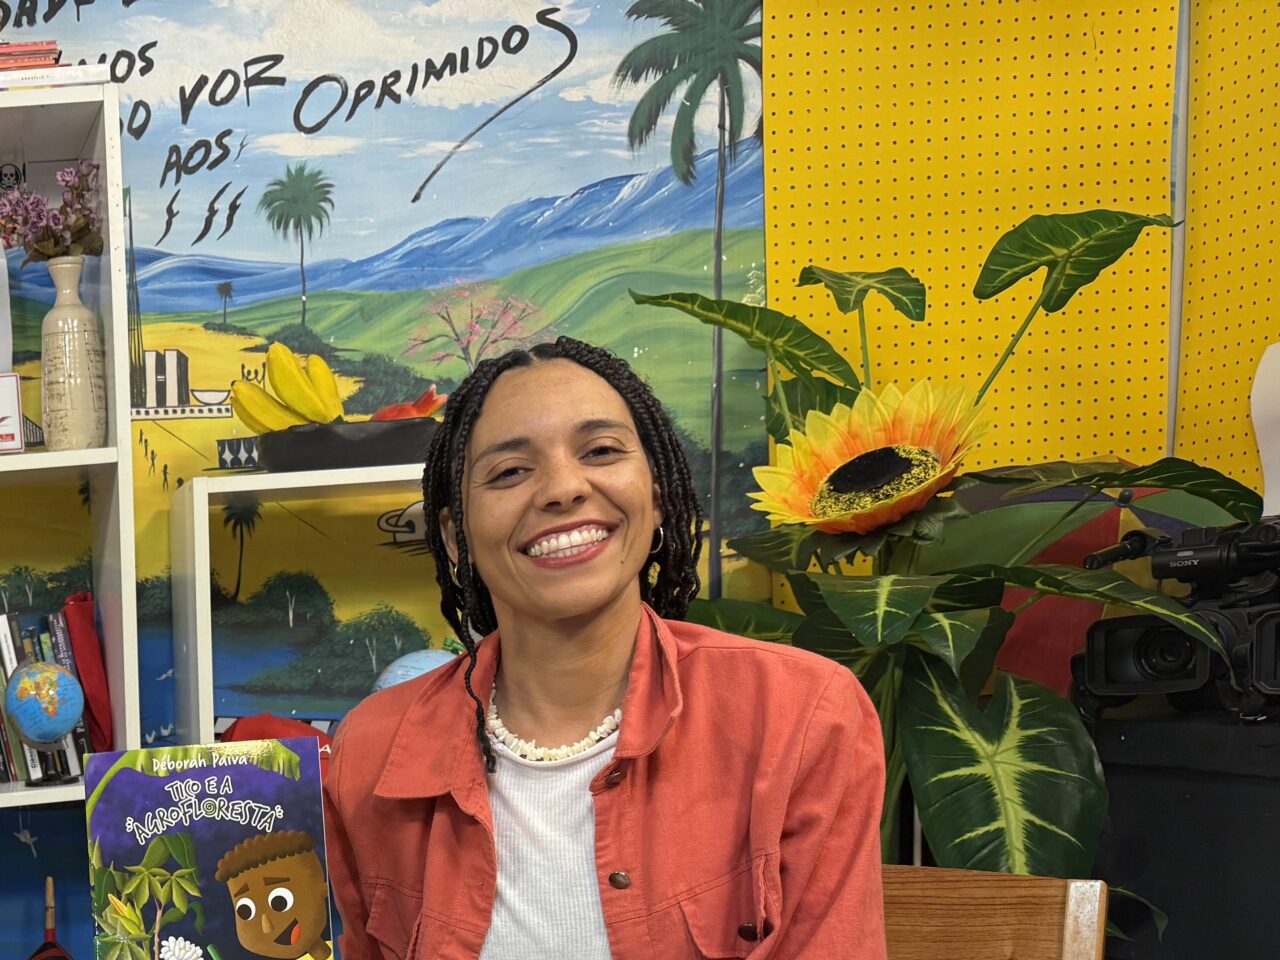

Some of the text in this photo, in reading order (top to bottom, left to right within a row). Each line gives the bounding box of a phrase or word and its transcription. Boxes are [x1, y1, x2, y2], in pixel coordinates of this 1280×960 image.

[293, 7, 578, 203] OPRIMIDOS
[160, 128, 234, 188] AOS
[1169, 559, 1200, 568] SONY
[152, 751, 248, 772] Déborah Paiva
[165, 775, 234, 802] TICO E A
